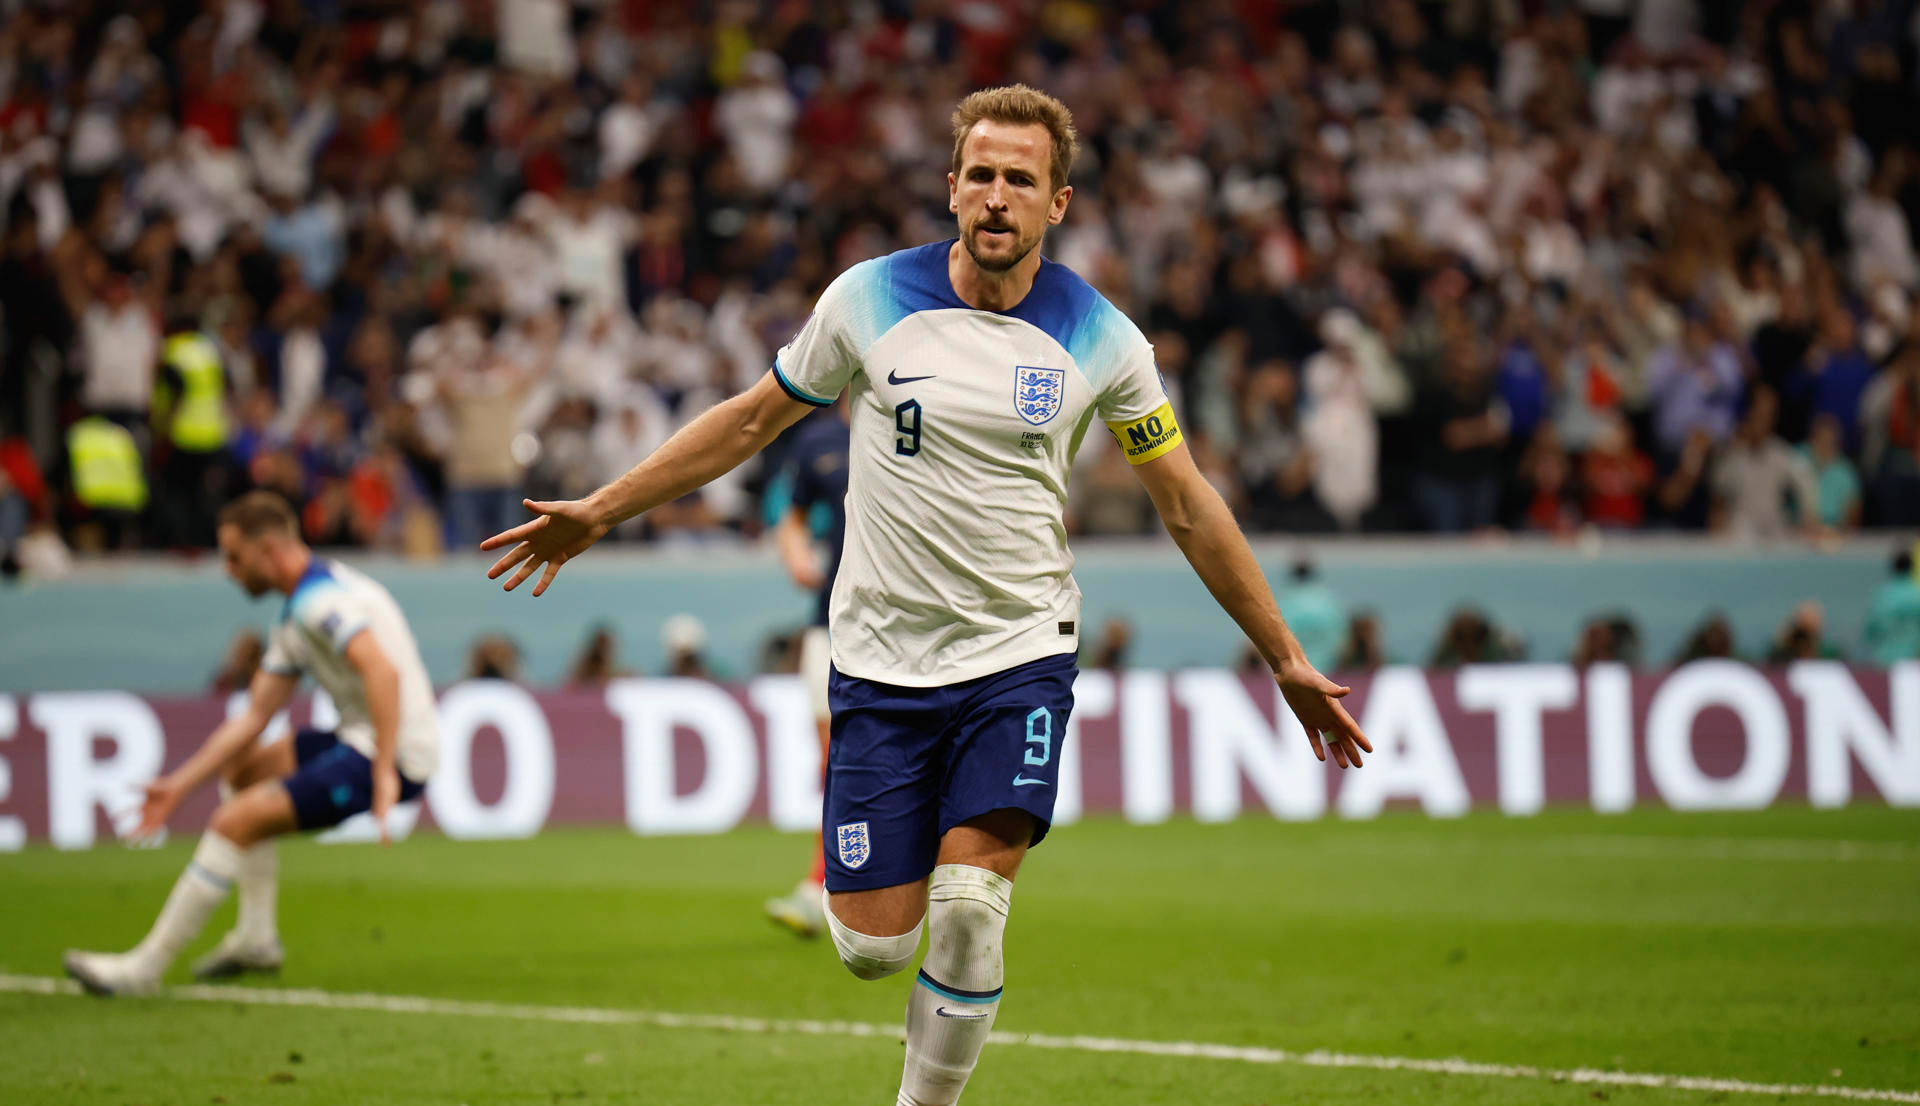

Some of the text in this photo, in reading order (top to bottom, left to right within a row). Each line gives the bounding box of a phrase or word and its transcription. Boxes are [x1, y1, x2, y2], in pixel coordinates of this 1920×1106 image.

[896, 398, 922, 457] 9
[1127, 416, 1163, 446] NO
[604, 660, 1920, 837] DEINATION
[1024, 706, 1052, 767] 9
